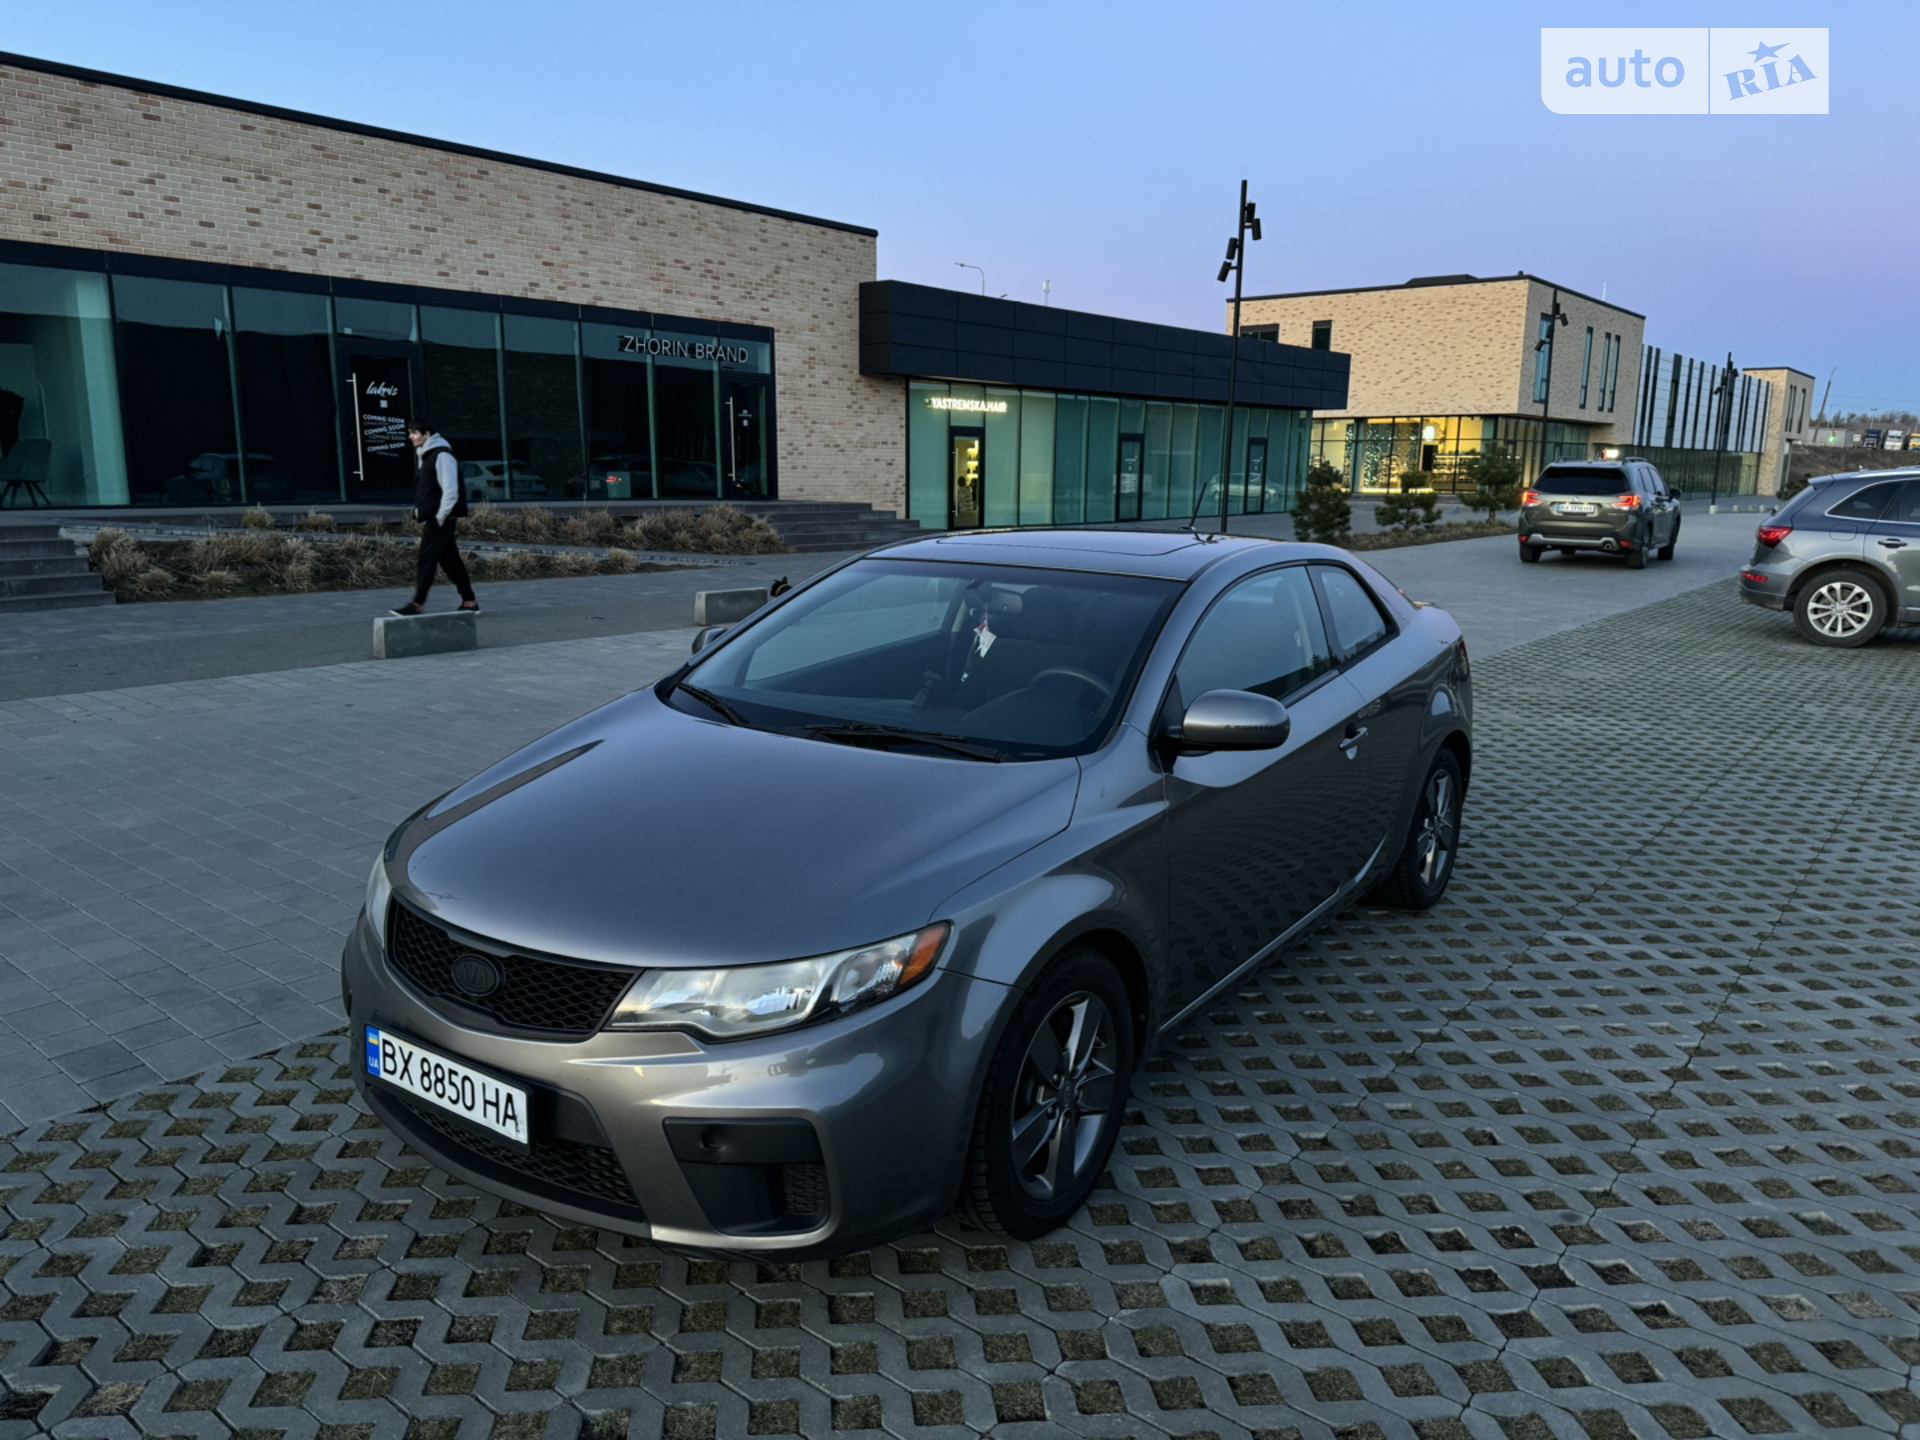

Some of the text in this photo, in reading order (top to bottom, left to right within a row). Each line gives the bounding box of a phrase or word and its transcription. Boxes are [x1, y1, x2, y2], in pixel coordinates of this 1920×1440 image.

[624, 335, 749, 363] ZHORIN BRAND
[364, 426, 387, 435] COMING
[367, 444, 388, 452] COMING
[368, 1056, 379, 1069] UA
[382, 1038, 520, 1132] BX 8850 HA
